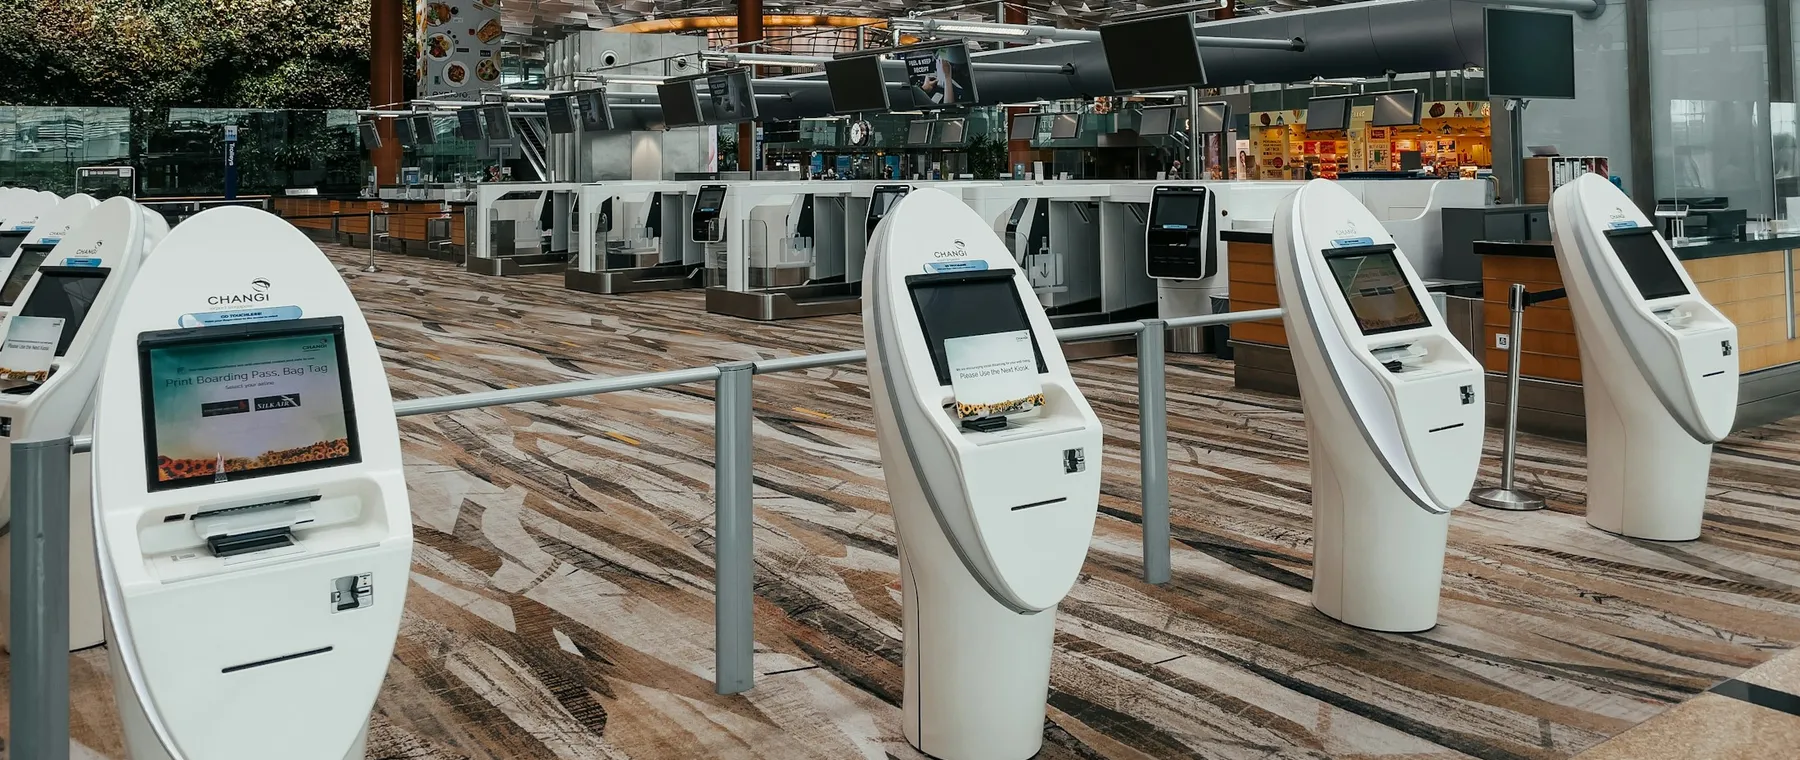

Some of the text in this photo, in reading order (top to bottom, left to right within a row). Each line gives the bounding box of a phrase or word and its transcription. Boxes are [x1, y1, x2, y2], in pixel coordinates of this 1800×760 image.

[933, 250, 968, 259] CHANGI
[207, 293, 270, 305] CHANGI
[165, 377, 193, 387] Print
[196, 372, 249, 385] Boarding
[283, 367, 305, 376] Bag
[308, 364, 328, 374] Tag
[960, 371, 979, 379] Please
[1001, 366, 1014, 374] Next
